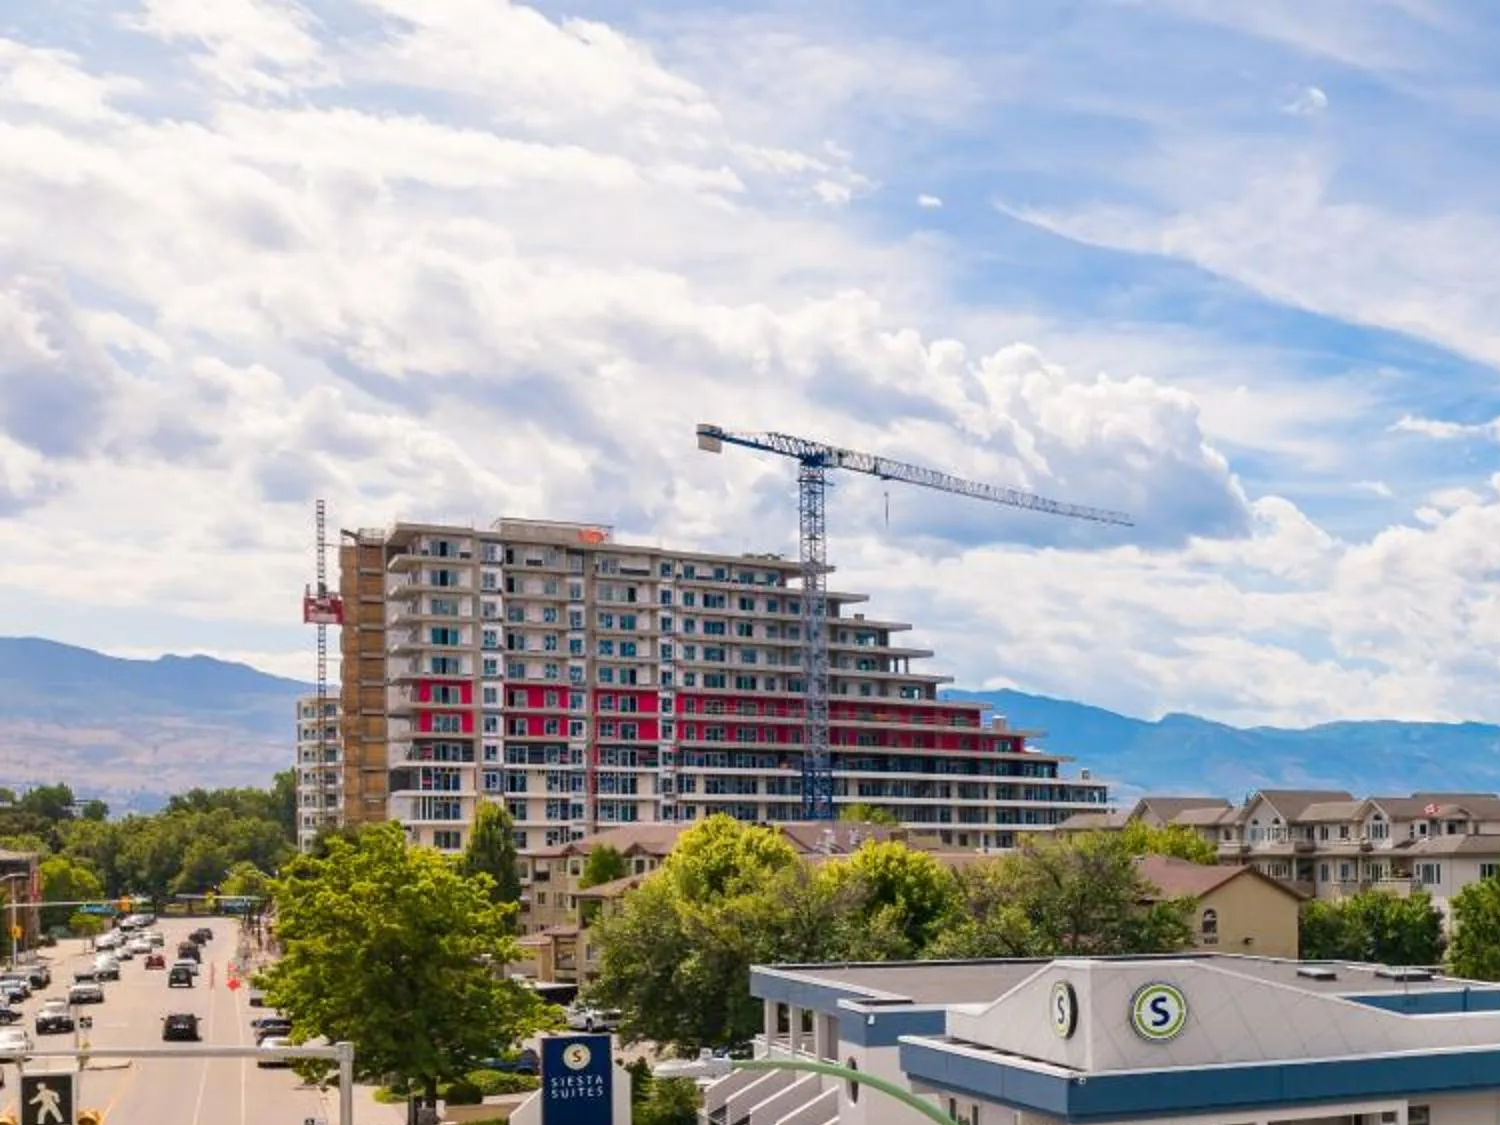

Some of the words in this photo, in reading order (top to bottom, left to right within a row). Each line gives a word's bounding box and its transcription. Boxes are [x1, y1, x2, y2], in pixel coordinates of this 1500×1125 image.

[1057, 995, 1065, 1025] S
[1150, 996, 1171, 1027] S
[551, 1074, 604, 1088] SIESTA
[551, 1085, 604, 1099] SUITES
